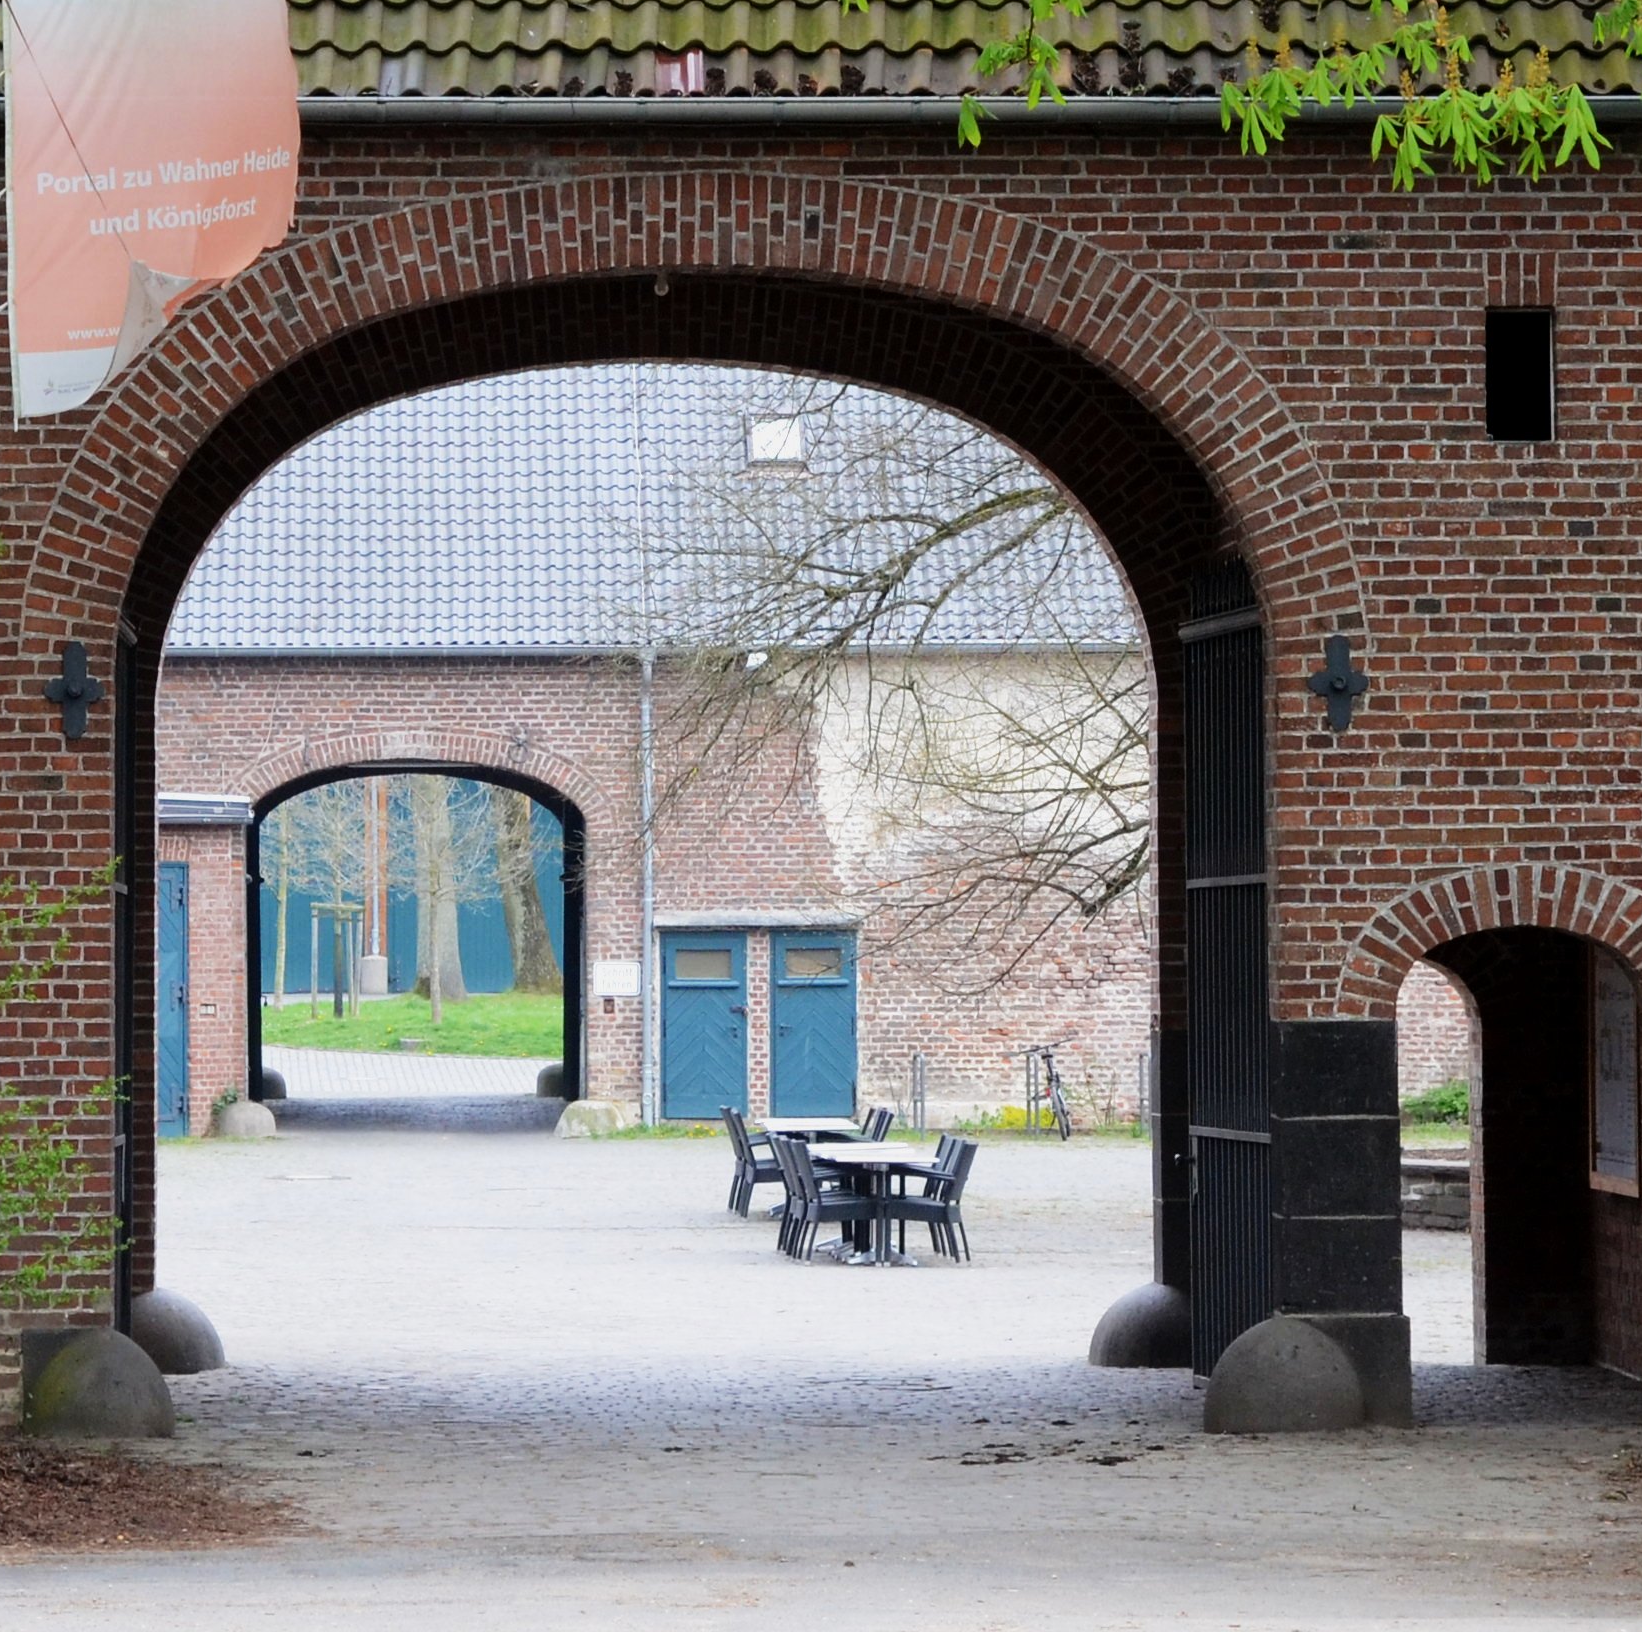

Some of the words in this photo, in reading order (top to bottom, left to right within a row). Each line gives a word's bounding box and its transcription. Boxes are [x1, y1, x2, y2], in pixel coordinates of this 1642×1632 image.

[37, 167, 115, 195] Portal
[123, 171, 152, 189] zu
[158, 157, 239, 185] Wahner
[243, 145, 290, 174] Heide
[90, 208, 140, 236] und
[147, 196, 257, 230] Königsforst
